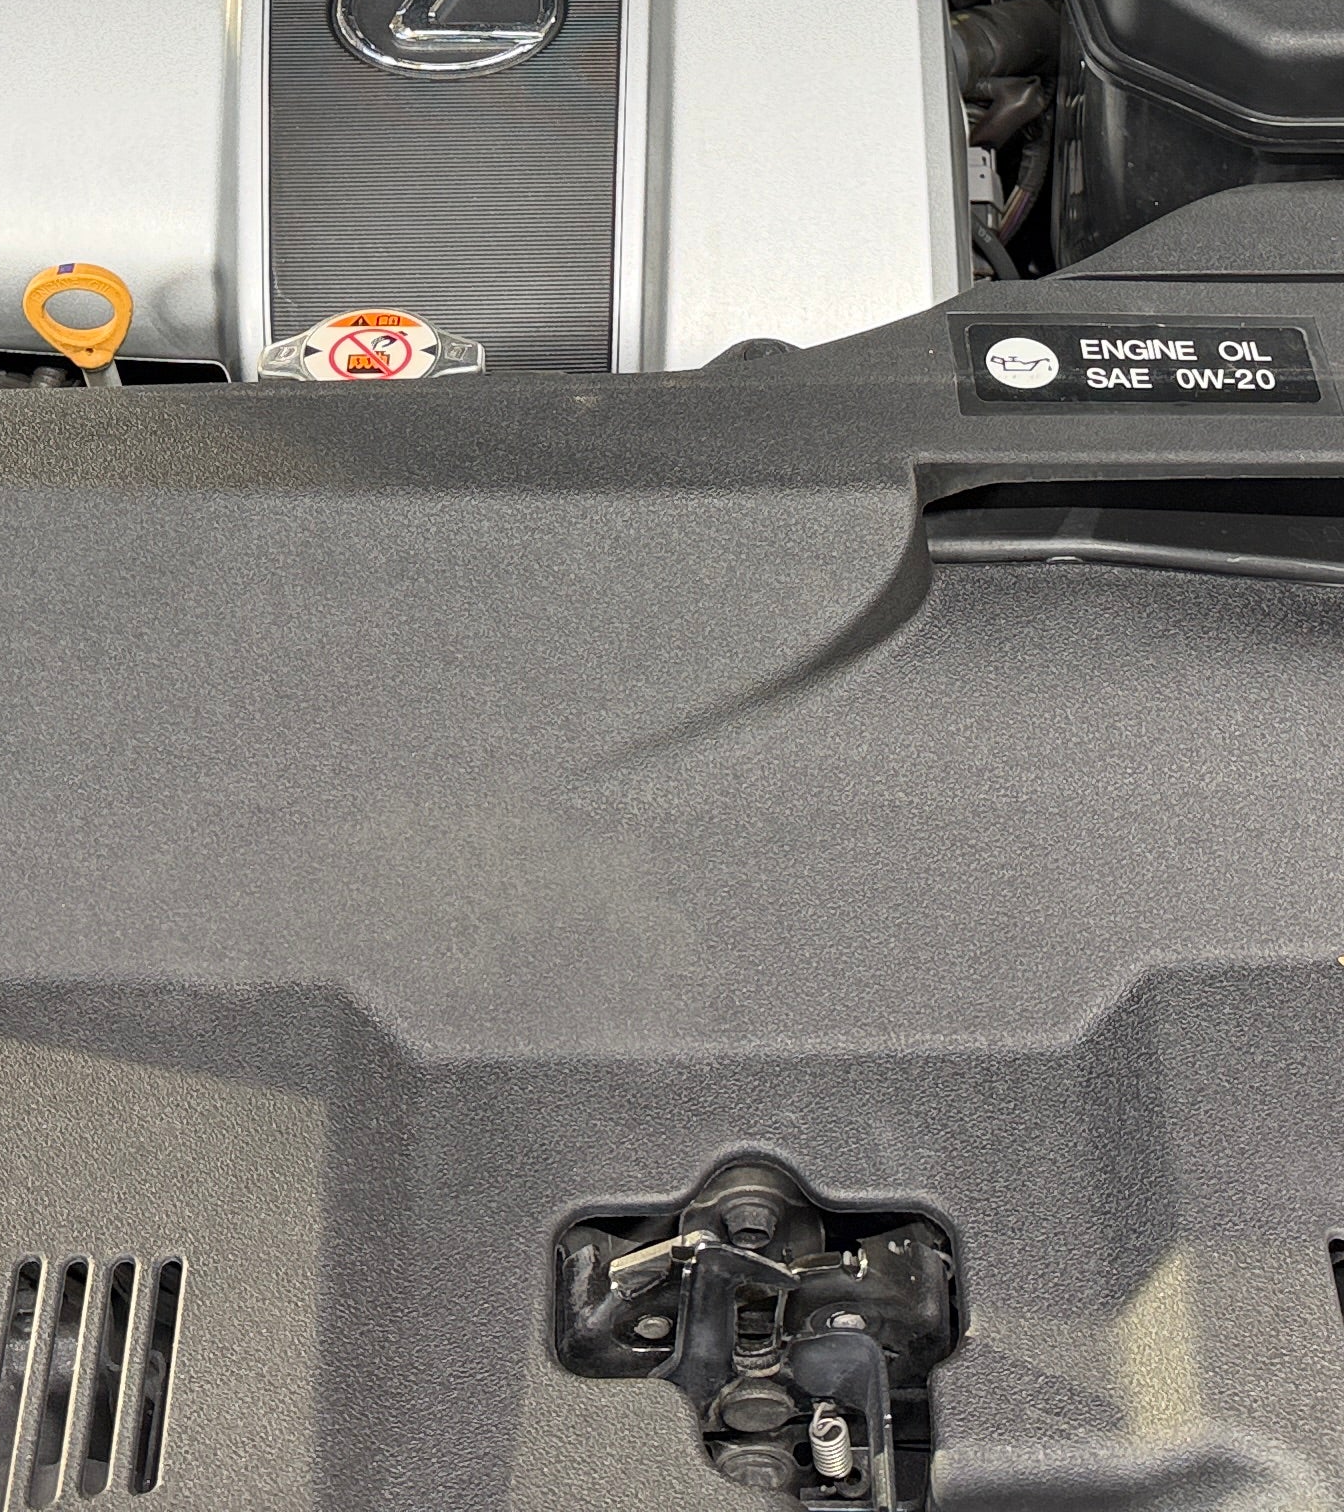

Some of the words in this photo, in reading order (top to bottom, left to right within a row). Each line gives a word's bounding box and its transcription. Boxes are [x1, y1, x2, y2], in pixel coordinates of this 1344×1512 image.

[1079, 339, 1198, 362] ENGINE
[1218, 340, 1272, 363] OIL
[1086, 367, 1153, 390] SAE
[1176, 368, 1276, 390] 0W-20
